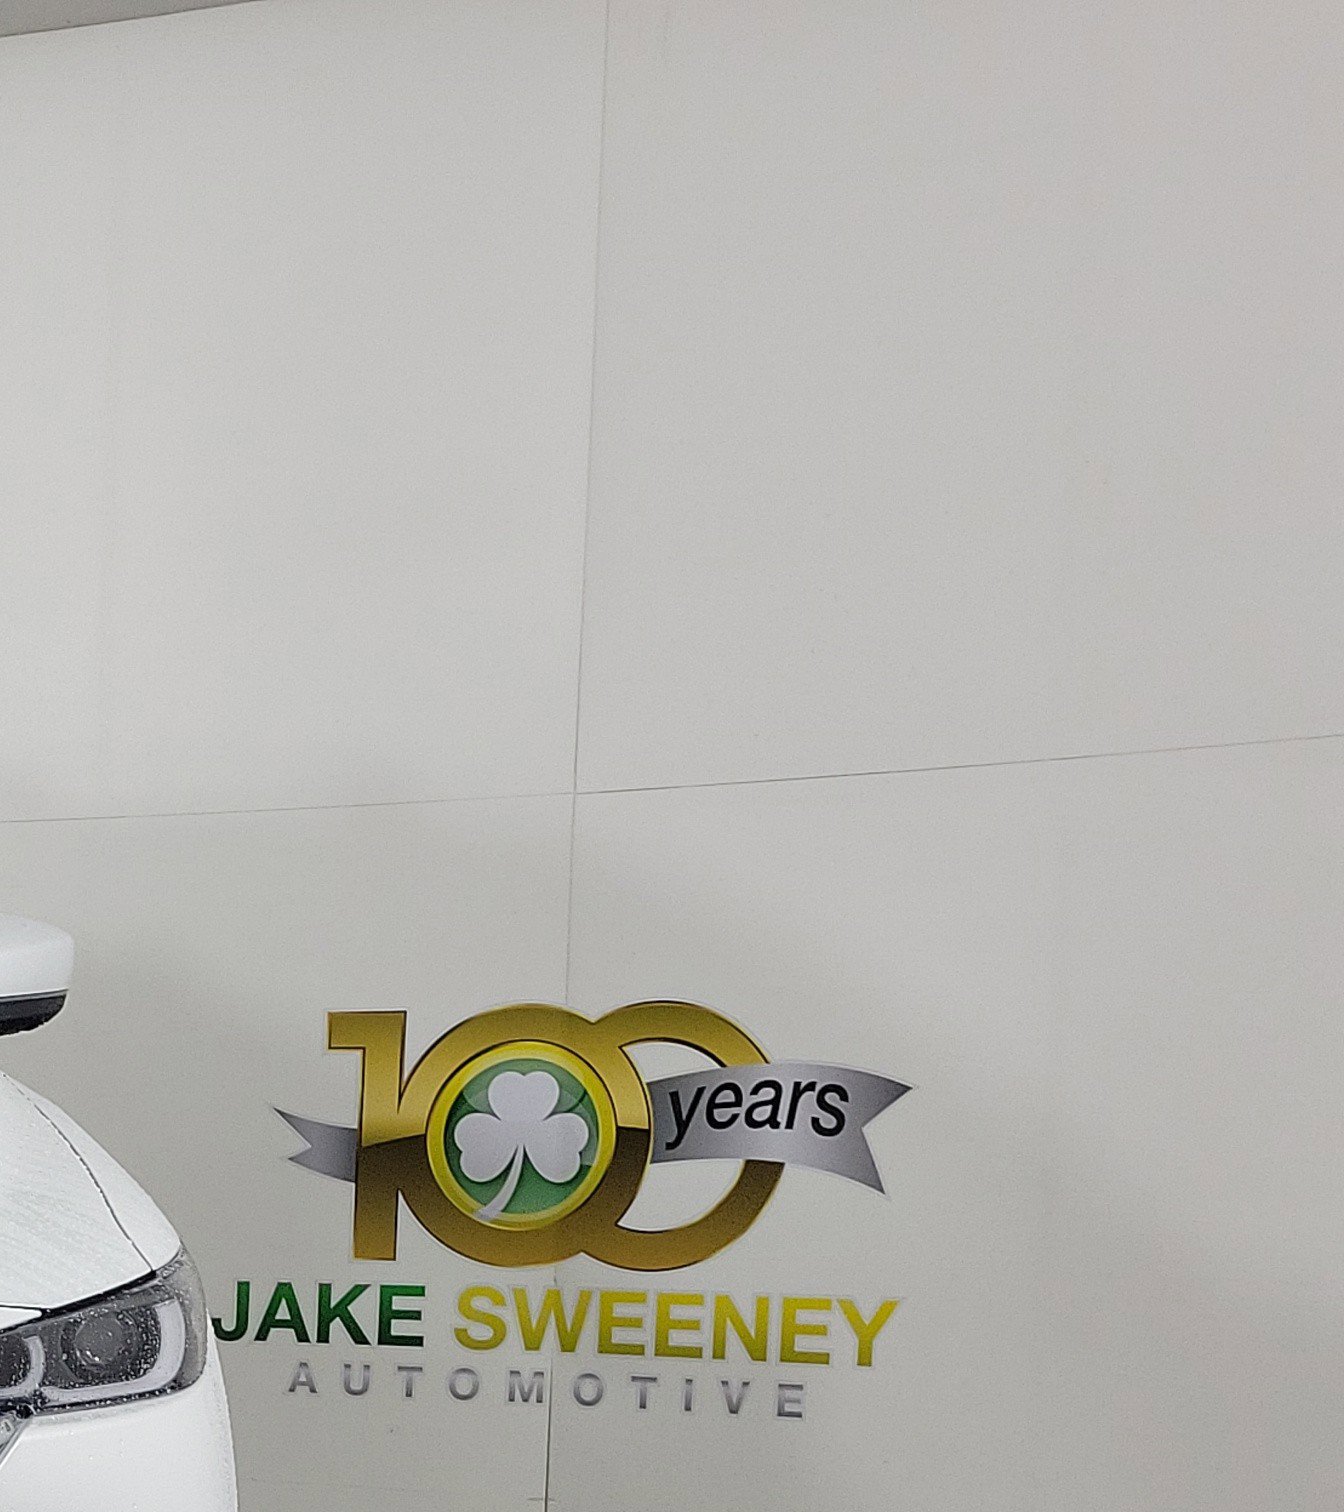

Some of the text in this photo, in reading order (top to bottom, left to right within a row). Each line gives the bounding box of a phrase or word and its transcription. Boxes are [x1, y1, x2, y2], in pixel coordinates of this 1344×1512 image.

[325, 1000, 851, 1272] 100 years
[212, 1281, 900, 1367] JAKE SWEENEY
[288, 1362, 805, 1418] AUTOMOTIVE
